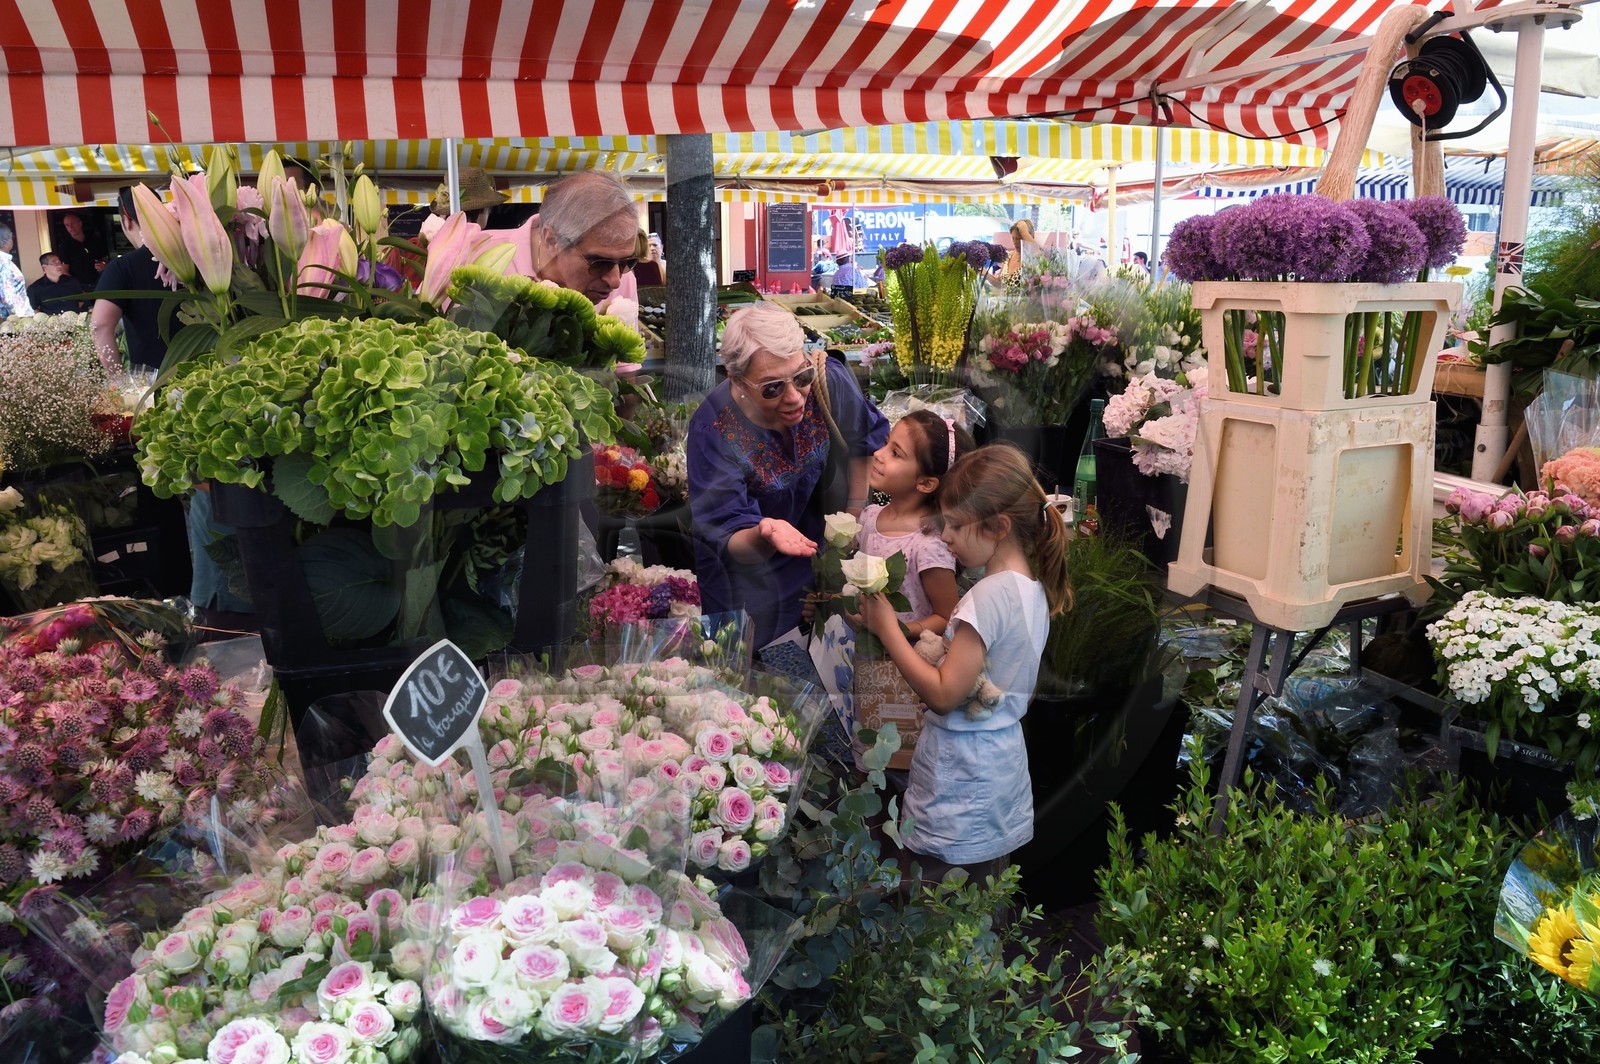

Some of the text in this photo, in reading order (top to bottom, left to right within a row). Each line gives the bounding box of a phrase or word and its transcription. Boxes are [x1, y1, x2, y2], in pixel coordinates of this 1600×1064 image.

[869, 233, 900, 241] ITALY
[407, 653, 462, 718] 10€
[427, 676, 480, 738] bouquet
[1521, 749, 1539, 758] SICA
